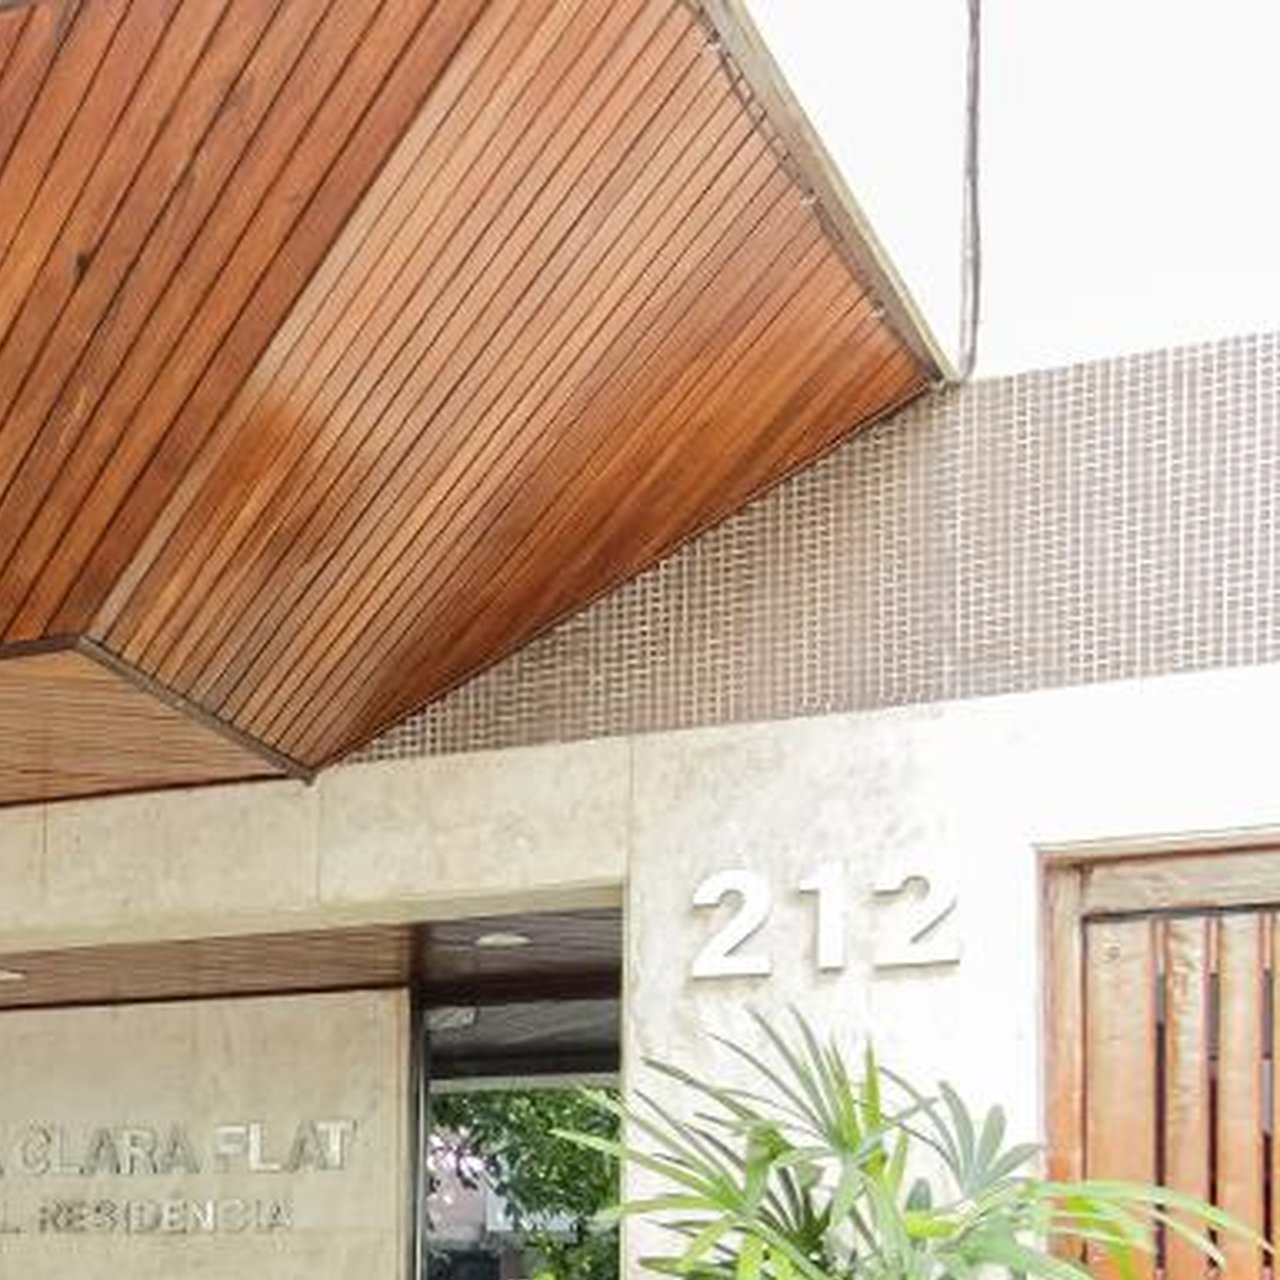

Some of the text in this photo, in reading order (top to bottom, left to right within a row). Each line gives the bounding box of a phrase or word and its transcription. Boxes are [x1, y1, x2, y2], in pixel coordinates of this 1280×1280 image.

[691, 865, 961, 980] 212
[21, 1119, 201, 1177] CLARA
[213, 1118, 359, 1173] FLAT
